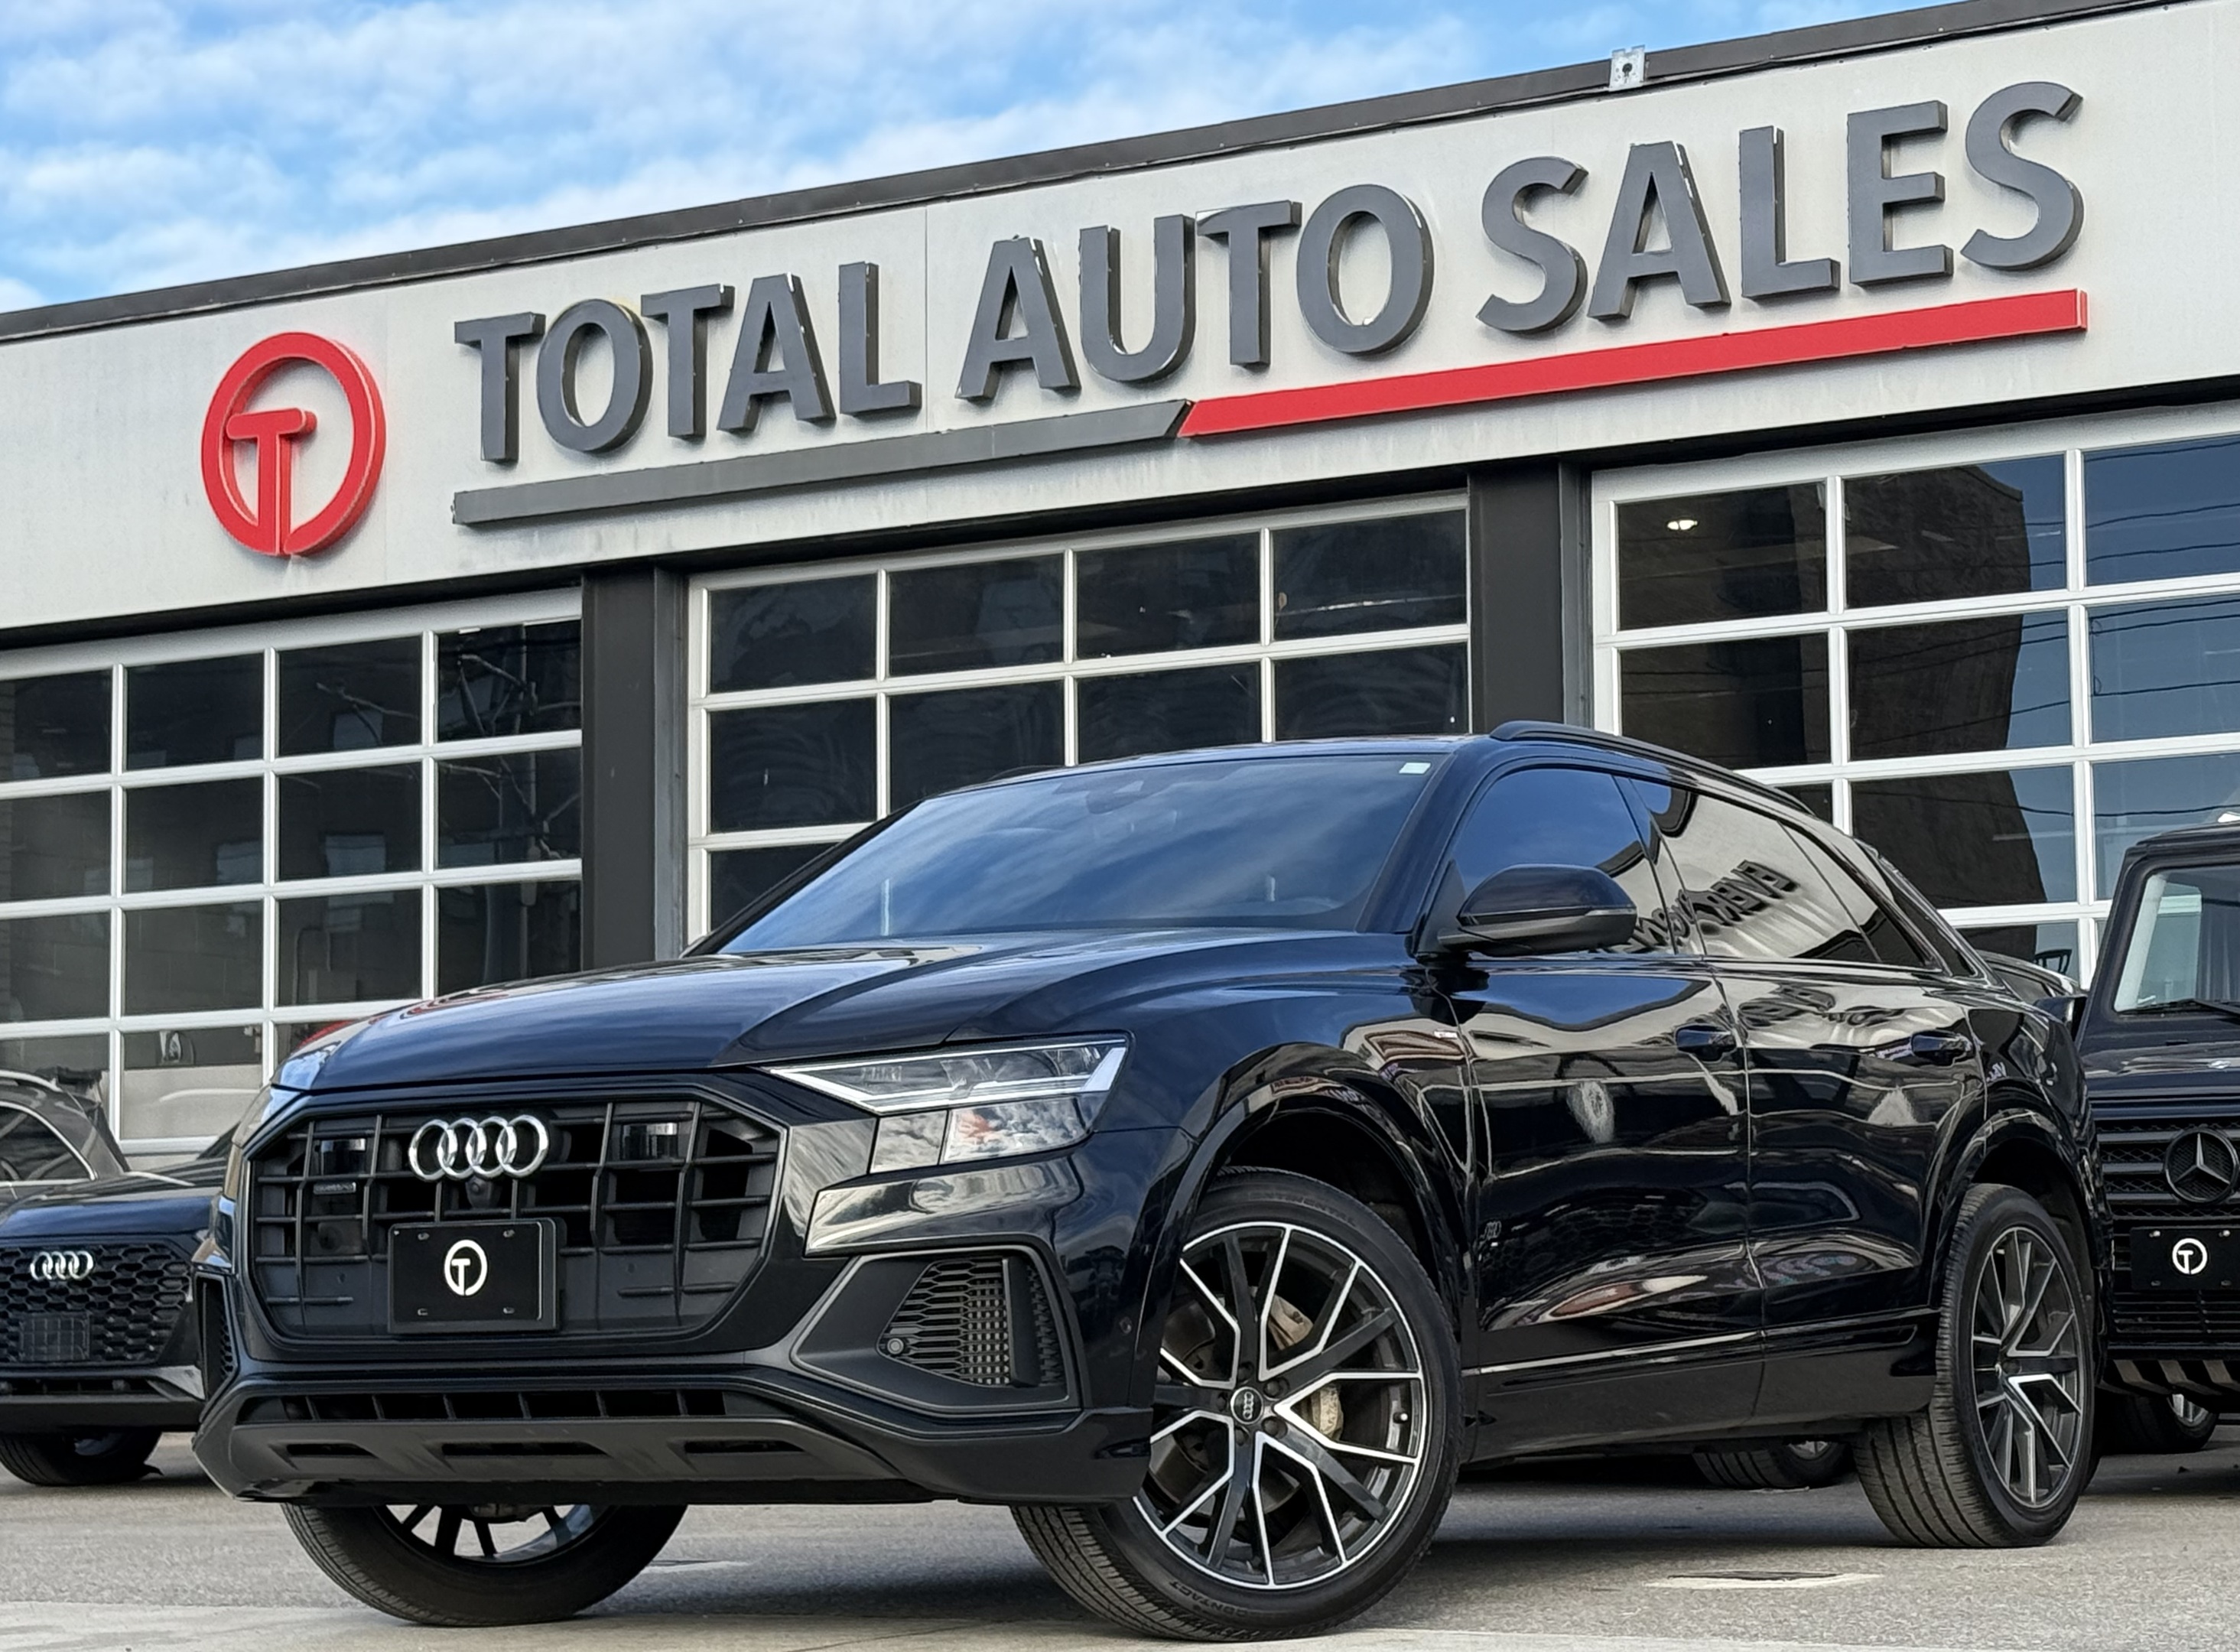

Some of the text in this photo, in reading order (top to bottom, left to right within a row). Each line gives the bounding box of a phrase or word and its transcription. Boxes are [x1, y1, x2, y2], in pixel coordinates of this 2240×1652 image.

[454, 81, 2084, 463] TOTAL AUTO SALES
[1169, 1580, 1249, 1618] CONTACT
